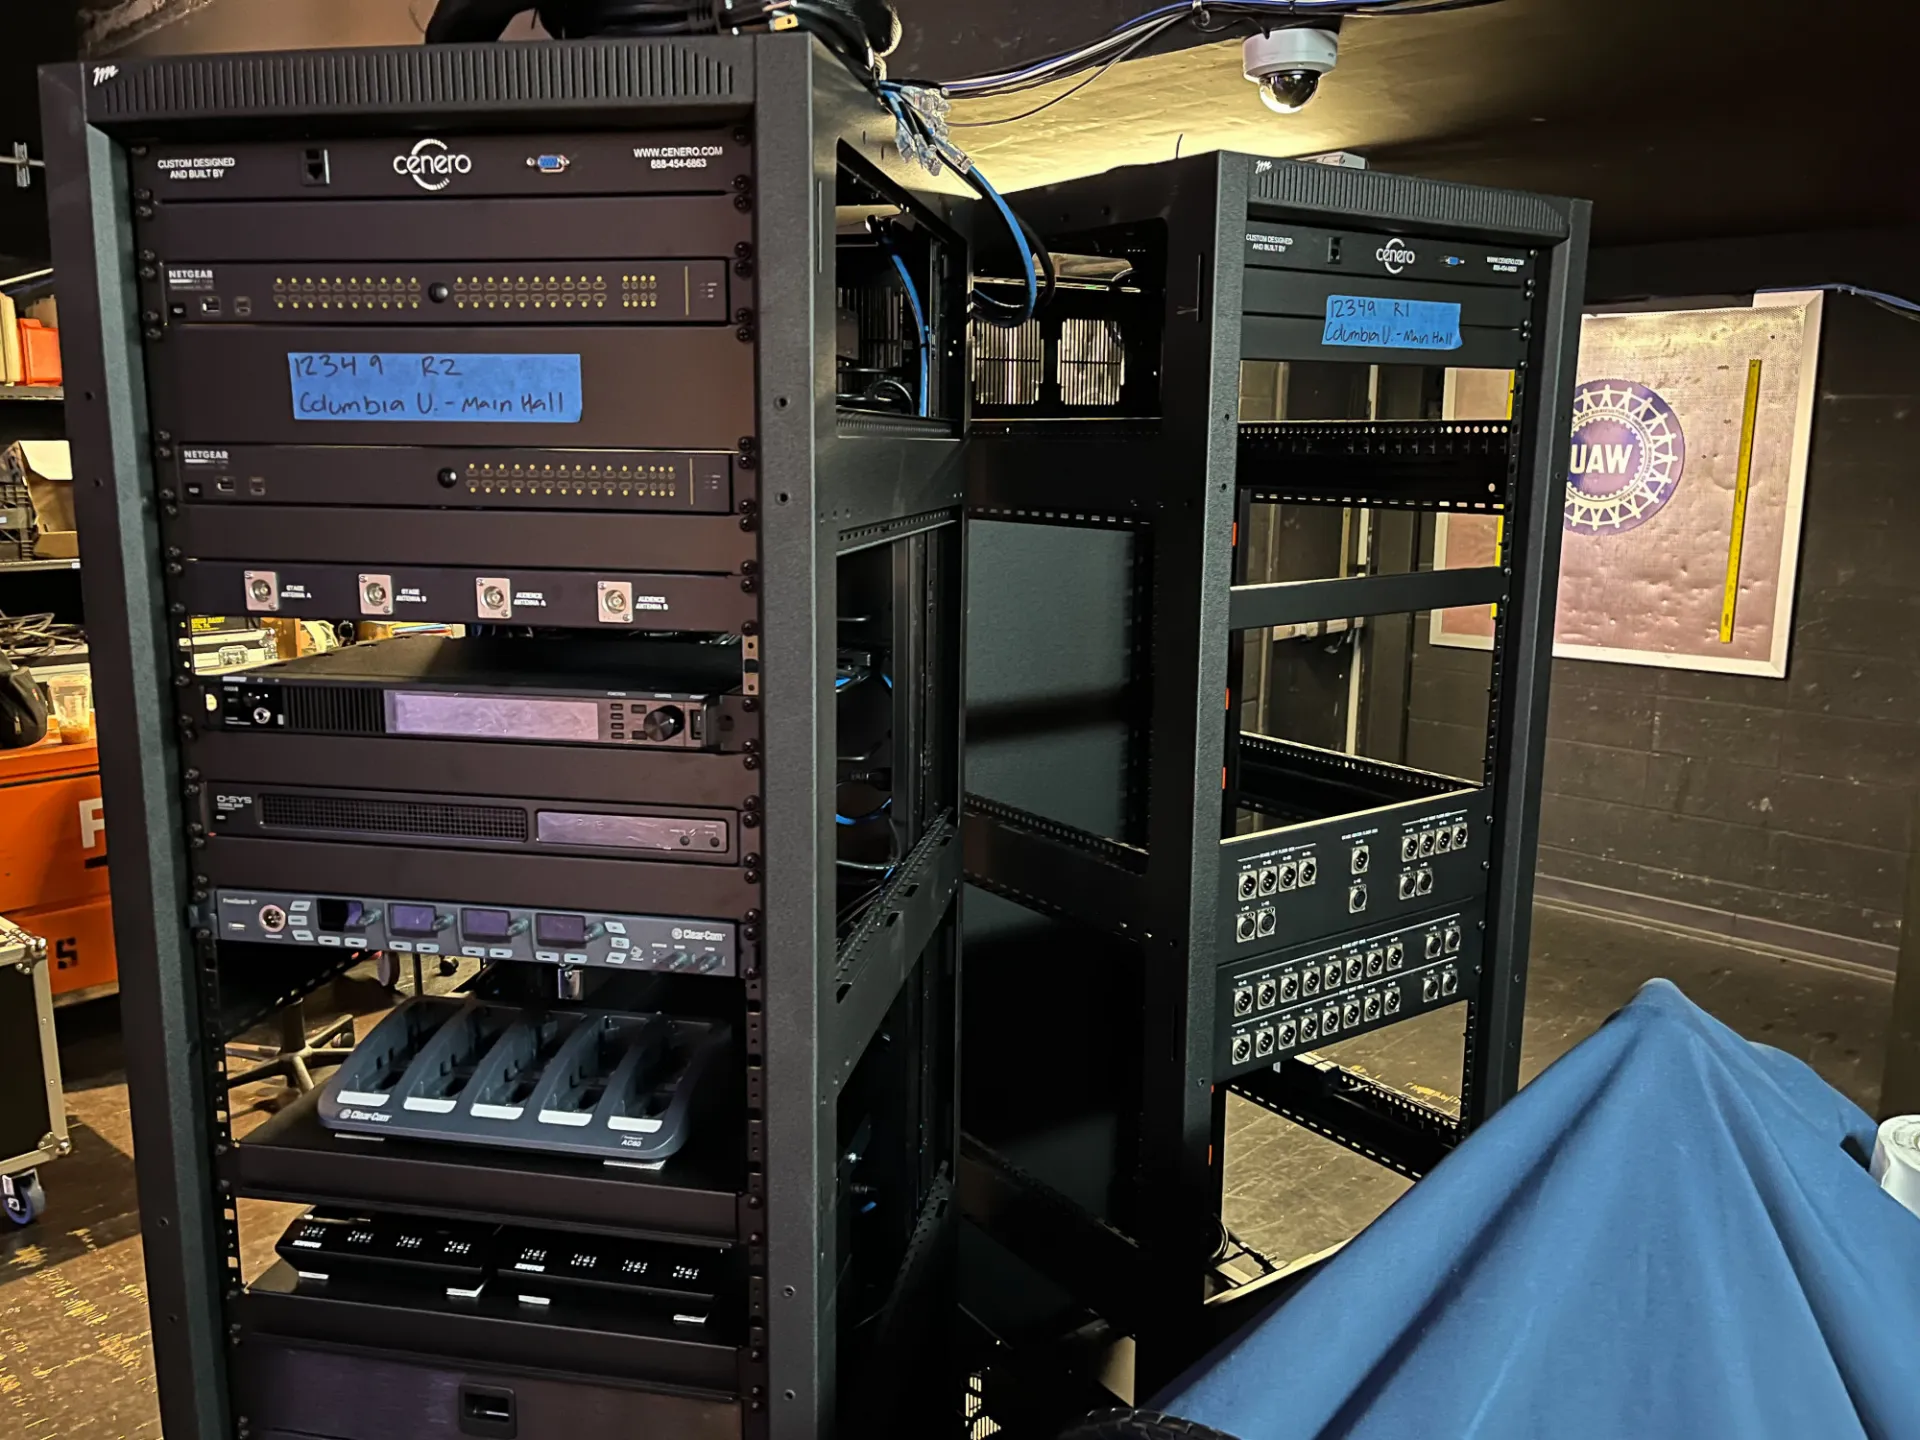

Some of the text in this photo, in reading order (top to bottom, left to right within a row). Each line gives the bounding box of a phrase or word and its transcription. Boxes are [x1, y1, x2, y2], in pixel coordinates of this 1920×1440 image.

[633, 146, 723, 158] WWW.CENERO.COM
[157, 157, 236, 169] CUSTOM DESIGNED
[170, 168, 225, 179] AND BUILT BY
[168, 269, 213, 279] NETGEAR
[1403, 329, 1430, 344] Main
[1432, 331, 1453, 346] Hall
[461, 397, 513, 414] Main
[520, 391, 565, 414] Hall
[183, 450, 229, 460] NETGEAR
[1570, 444, 1634, 475] UAW
